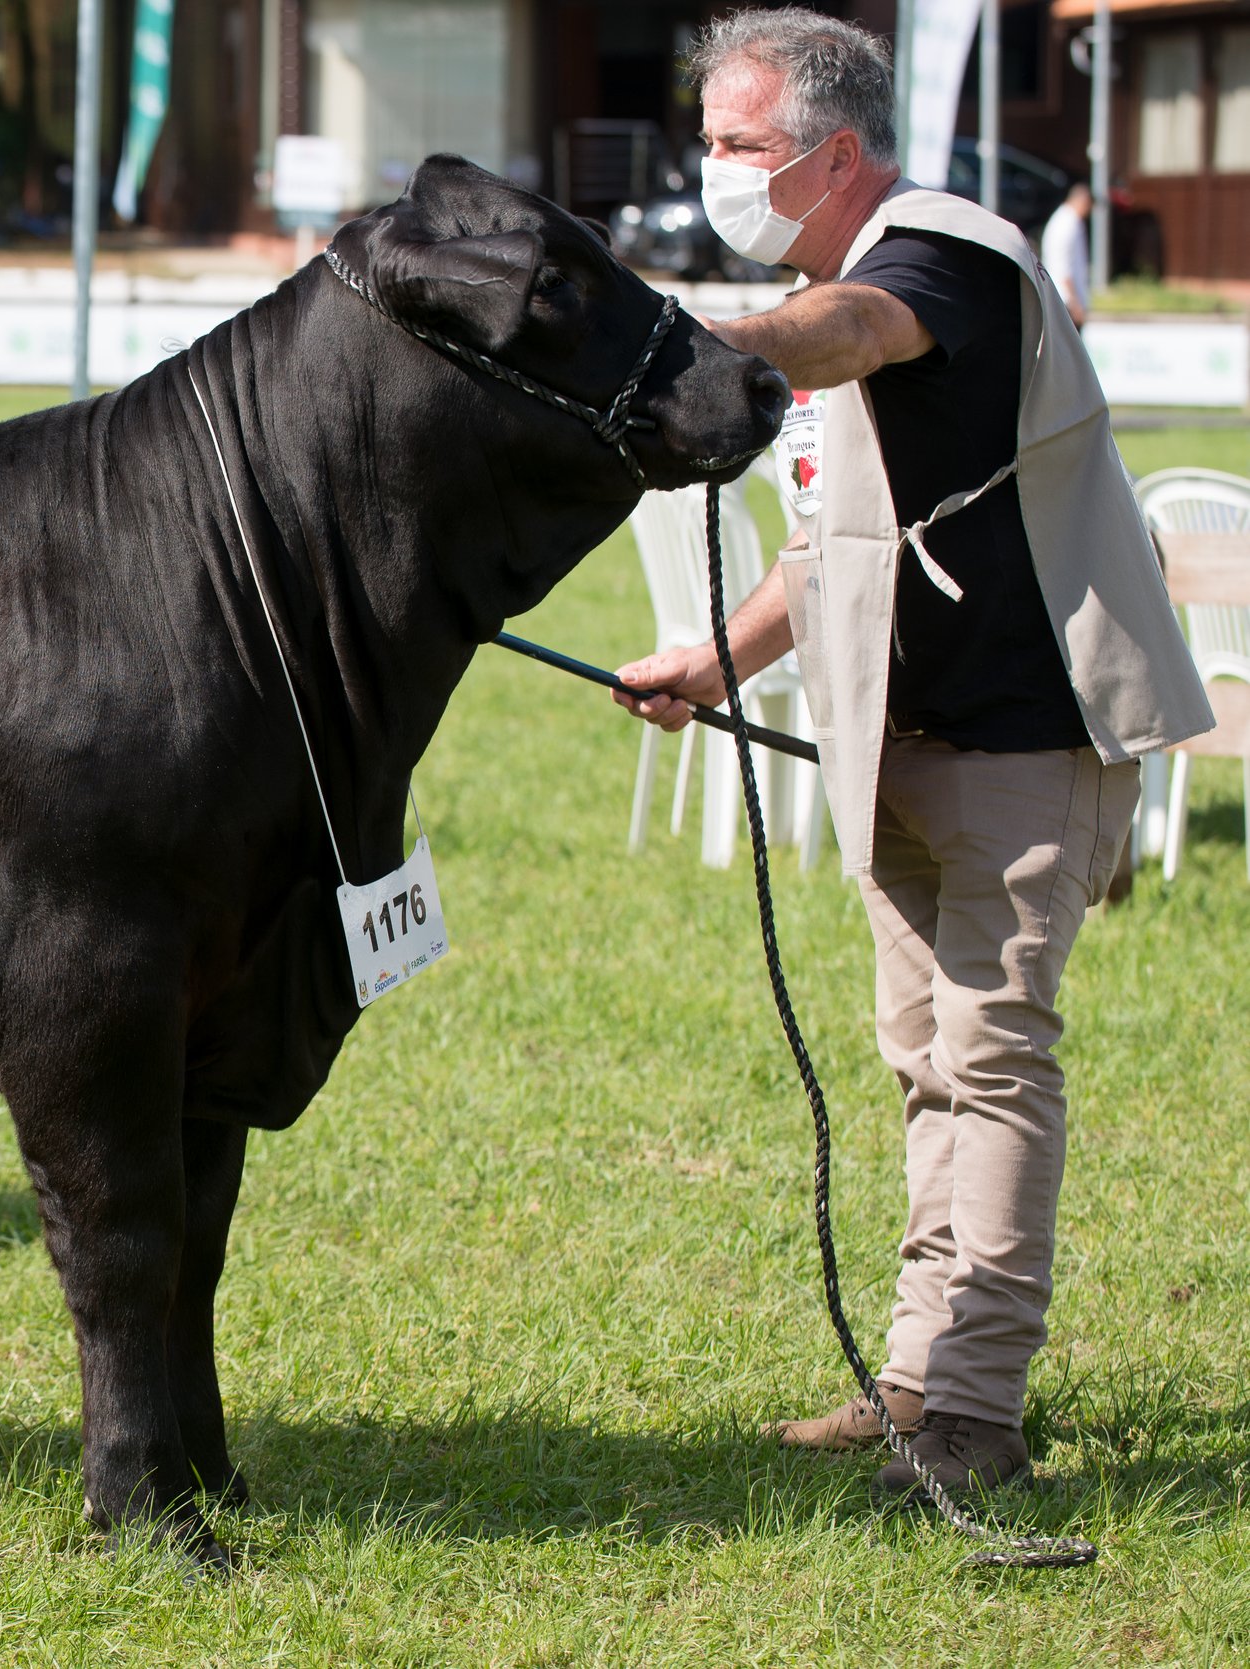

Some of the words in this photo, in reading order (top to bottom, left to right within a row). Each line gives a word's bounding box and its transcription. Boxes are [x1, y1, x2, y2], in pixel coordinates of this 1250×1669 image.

[362, 883, 427, 953] 1176
[410, 954, 429, 970] FARSUL
[374, 973, 399, 993] Expointer
